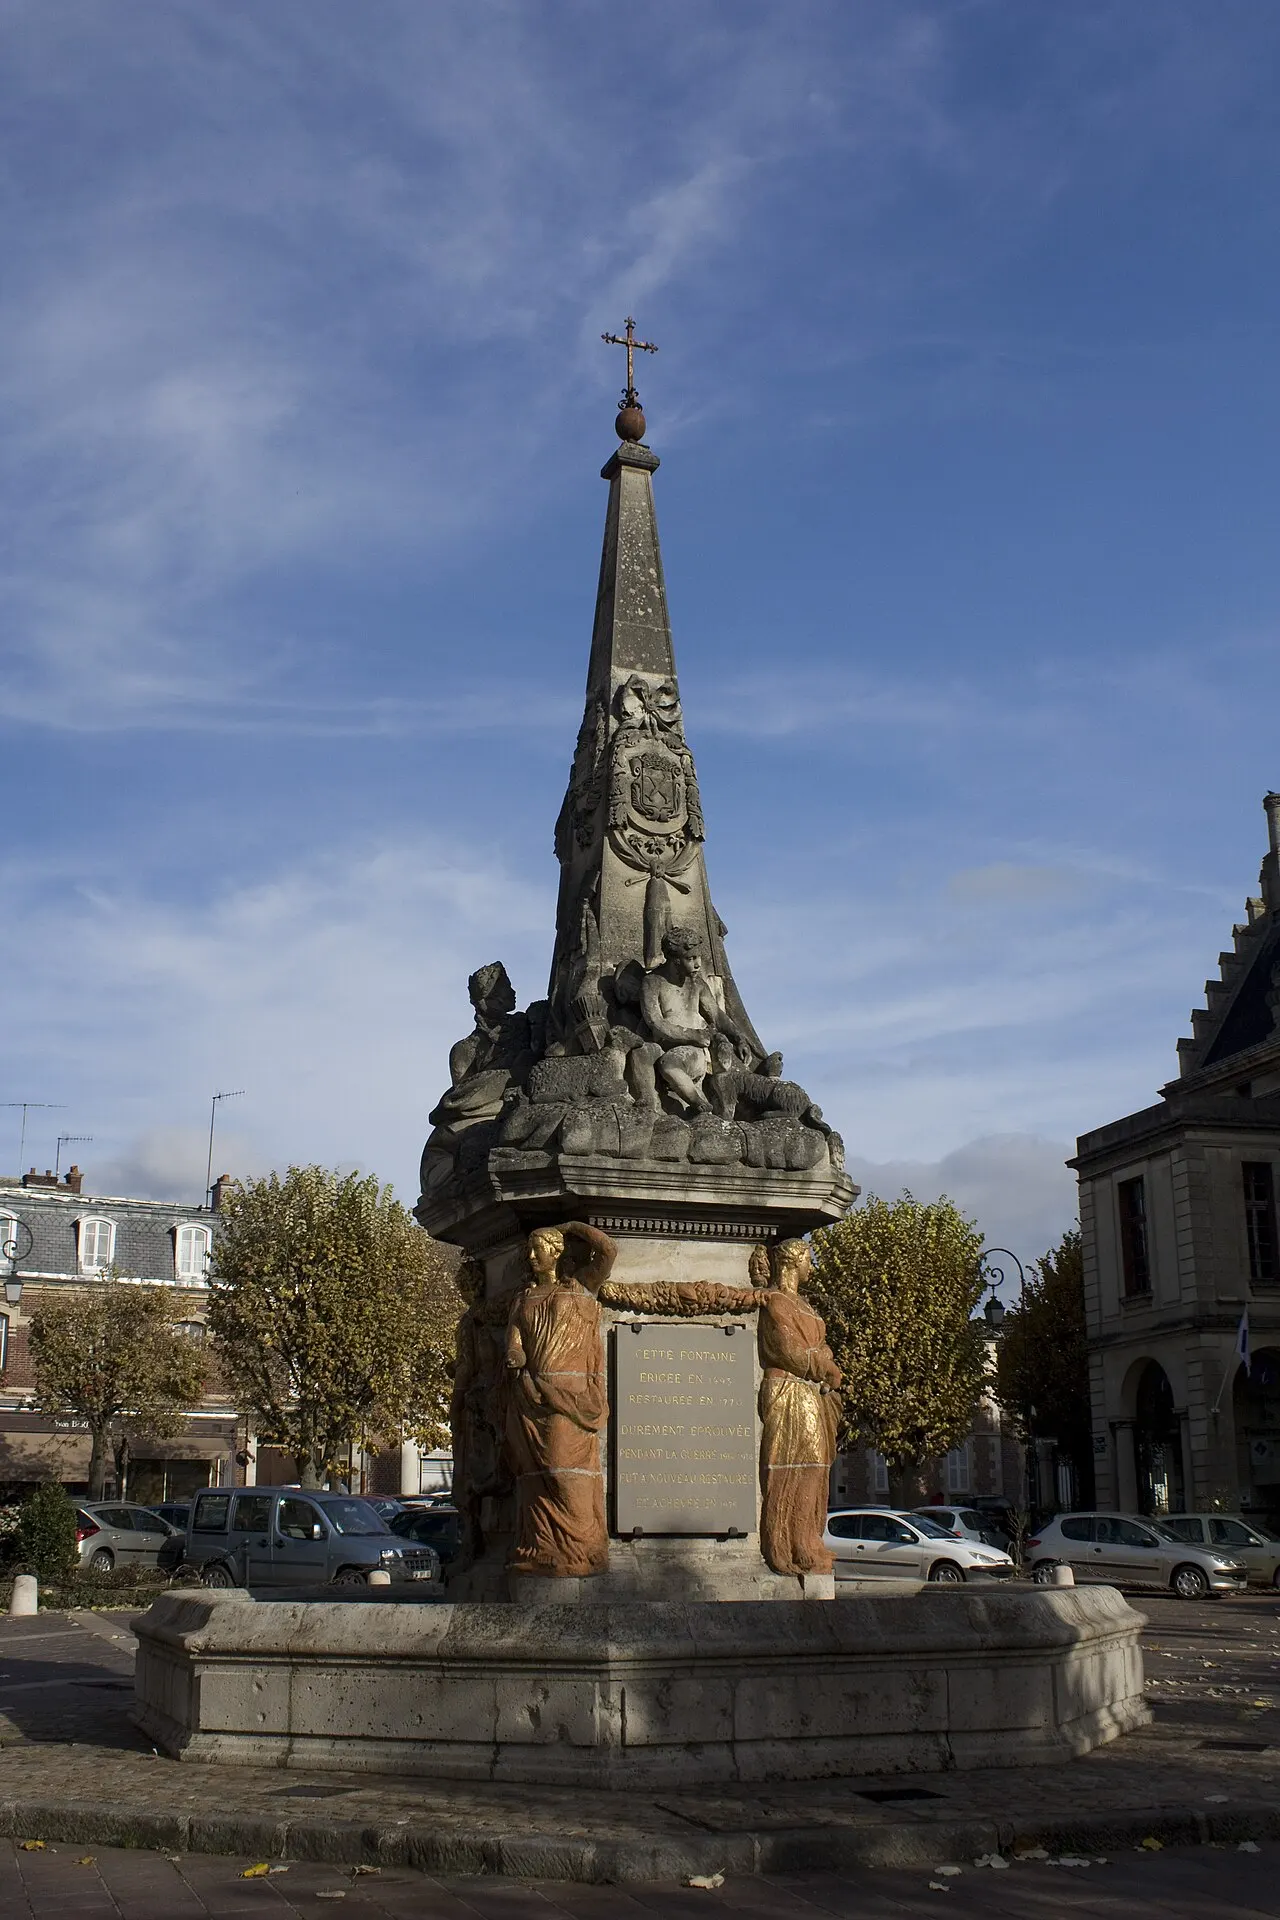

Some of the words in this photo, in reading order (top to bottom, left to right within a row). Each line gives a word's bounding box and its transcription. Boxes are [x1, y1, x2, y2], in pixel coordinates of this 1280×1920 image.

[635, 1349, 674, 1361] CETTE
[680, 1350, 737, 1363] FONTAINE
[688, 1373, 704, 1384] EN
[699, 1395, 714, 1406] EN
[621, 1424, 685, 1436] DUREMENT
[619, 1448, 663, 1460] PENDANT
[665, 1449, 678, 1460] LA
[680, 1449, 719, 1461] GUERRE
[649, 1472, 697, 1485] NOUVEAU
